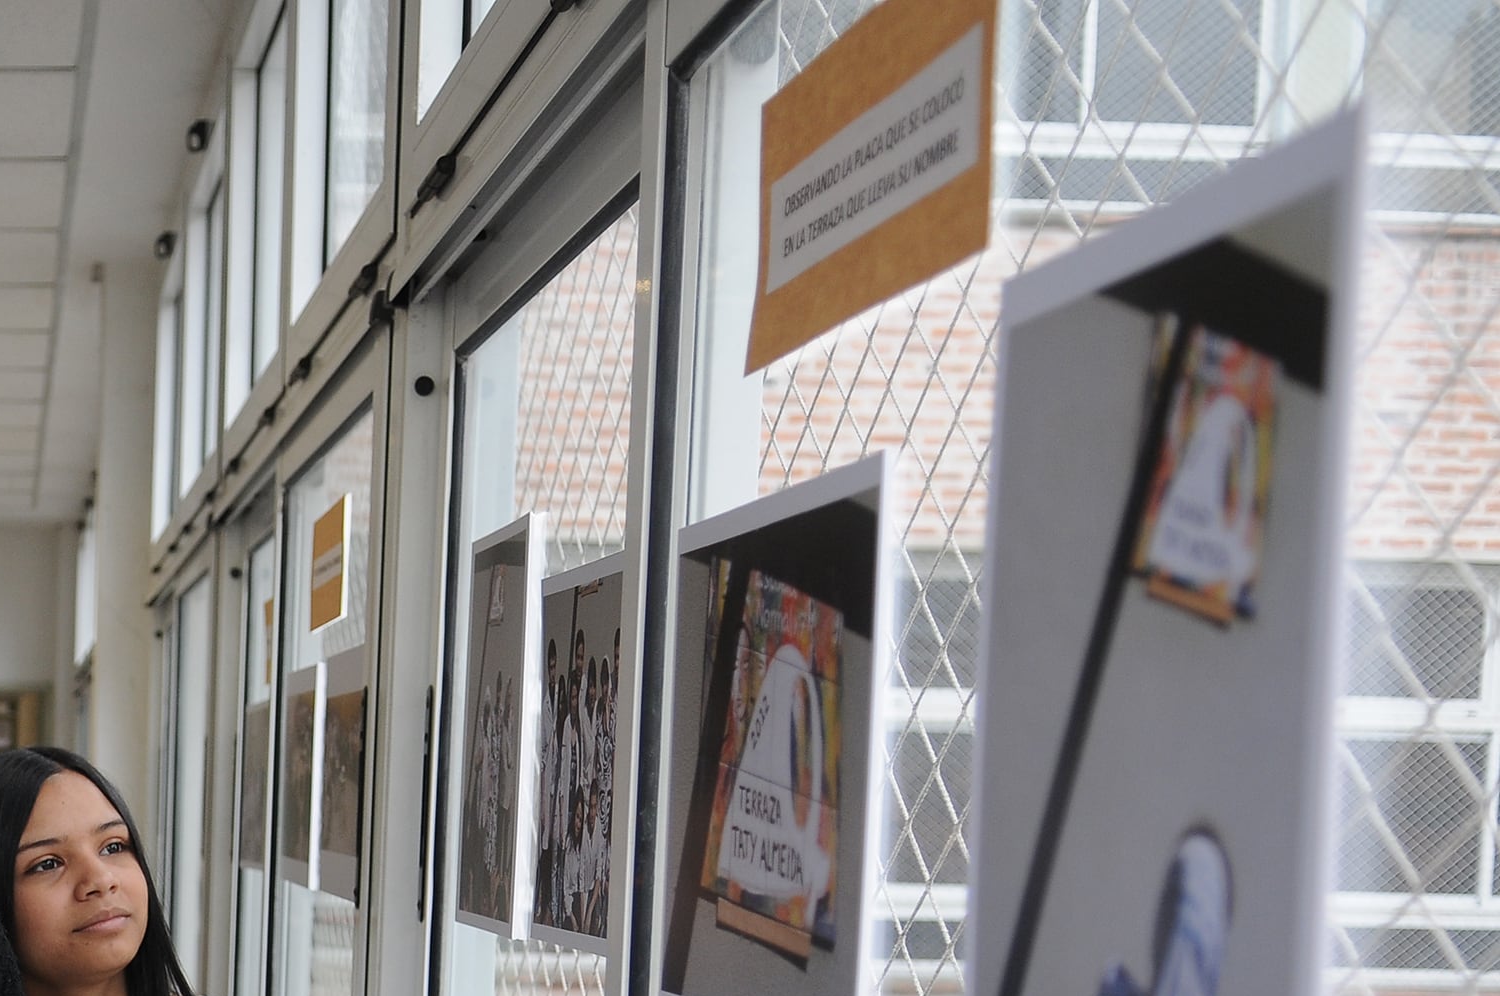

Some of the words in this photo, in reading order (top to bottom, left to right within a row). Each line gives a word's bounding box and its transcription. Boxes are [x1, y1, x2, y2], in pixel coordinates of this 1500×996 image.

[783, 235, 795, 258] EN
[796, 227, 806, 250] LA
[808, 203, 845, 242] TERRAZA
[847, 189, 866, 219] QUE
[868, 171, 896, 206] LLEVA
[898, 160, 912, 187] SU
[914, 128, 960, 178] NOMBRE
[784, 163, 840, 217] OBSERVANDO
[842, 154, 854, 180] LA
[854, 133, 884, 172] PLACA
[886, 116, 908, 151] QUE
[908, 106, 920, 135] SE
[739, 785, 782, 825] TERRAZA
[732, 826, 758, 864] TATY
[760, 838, 804, 887] ALMEIDA
